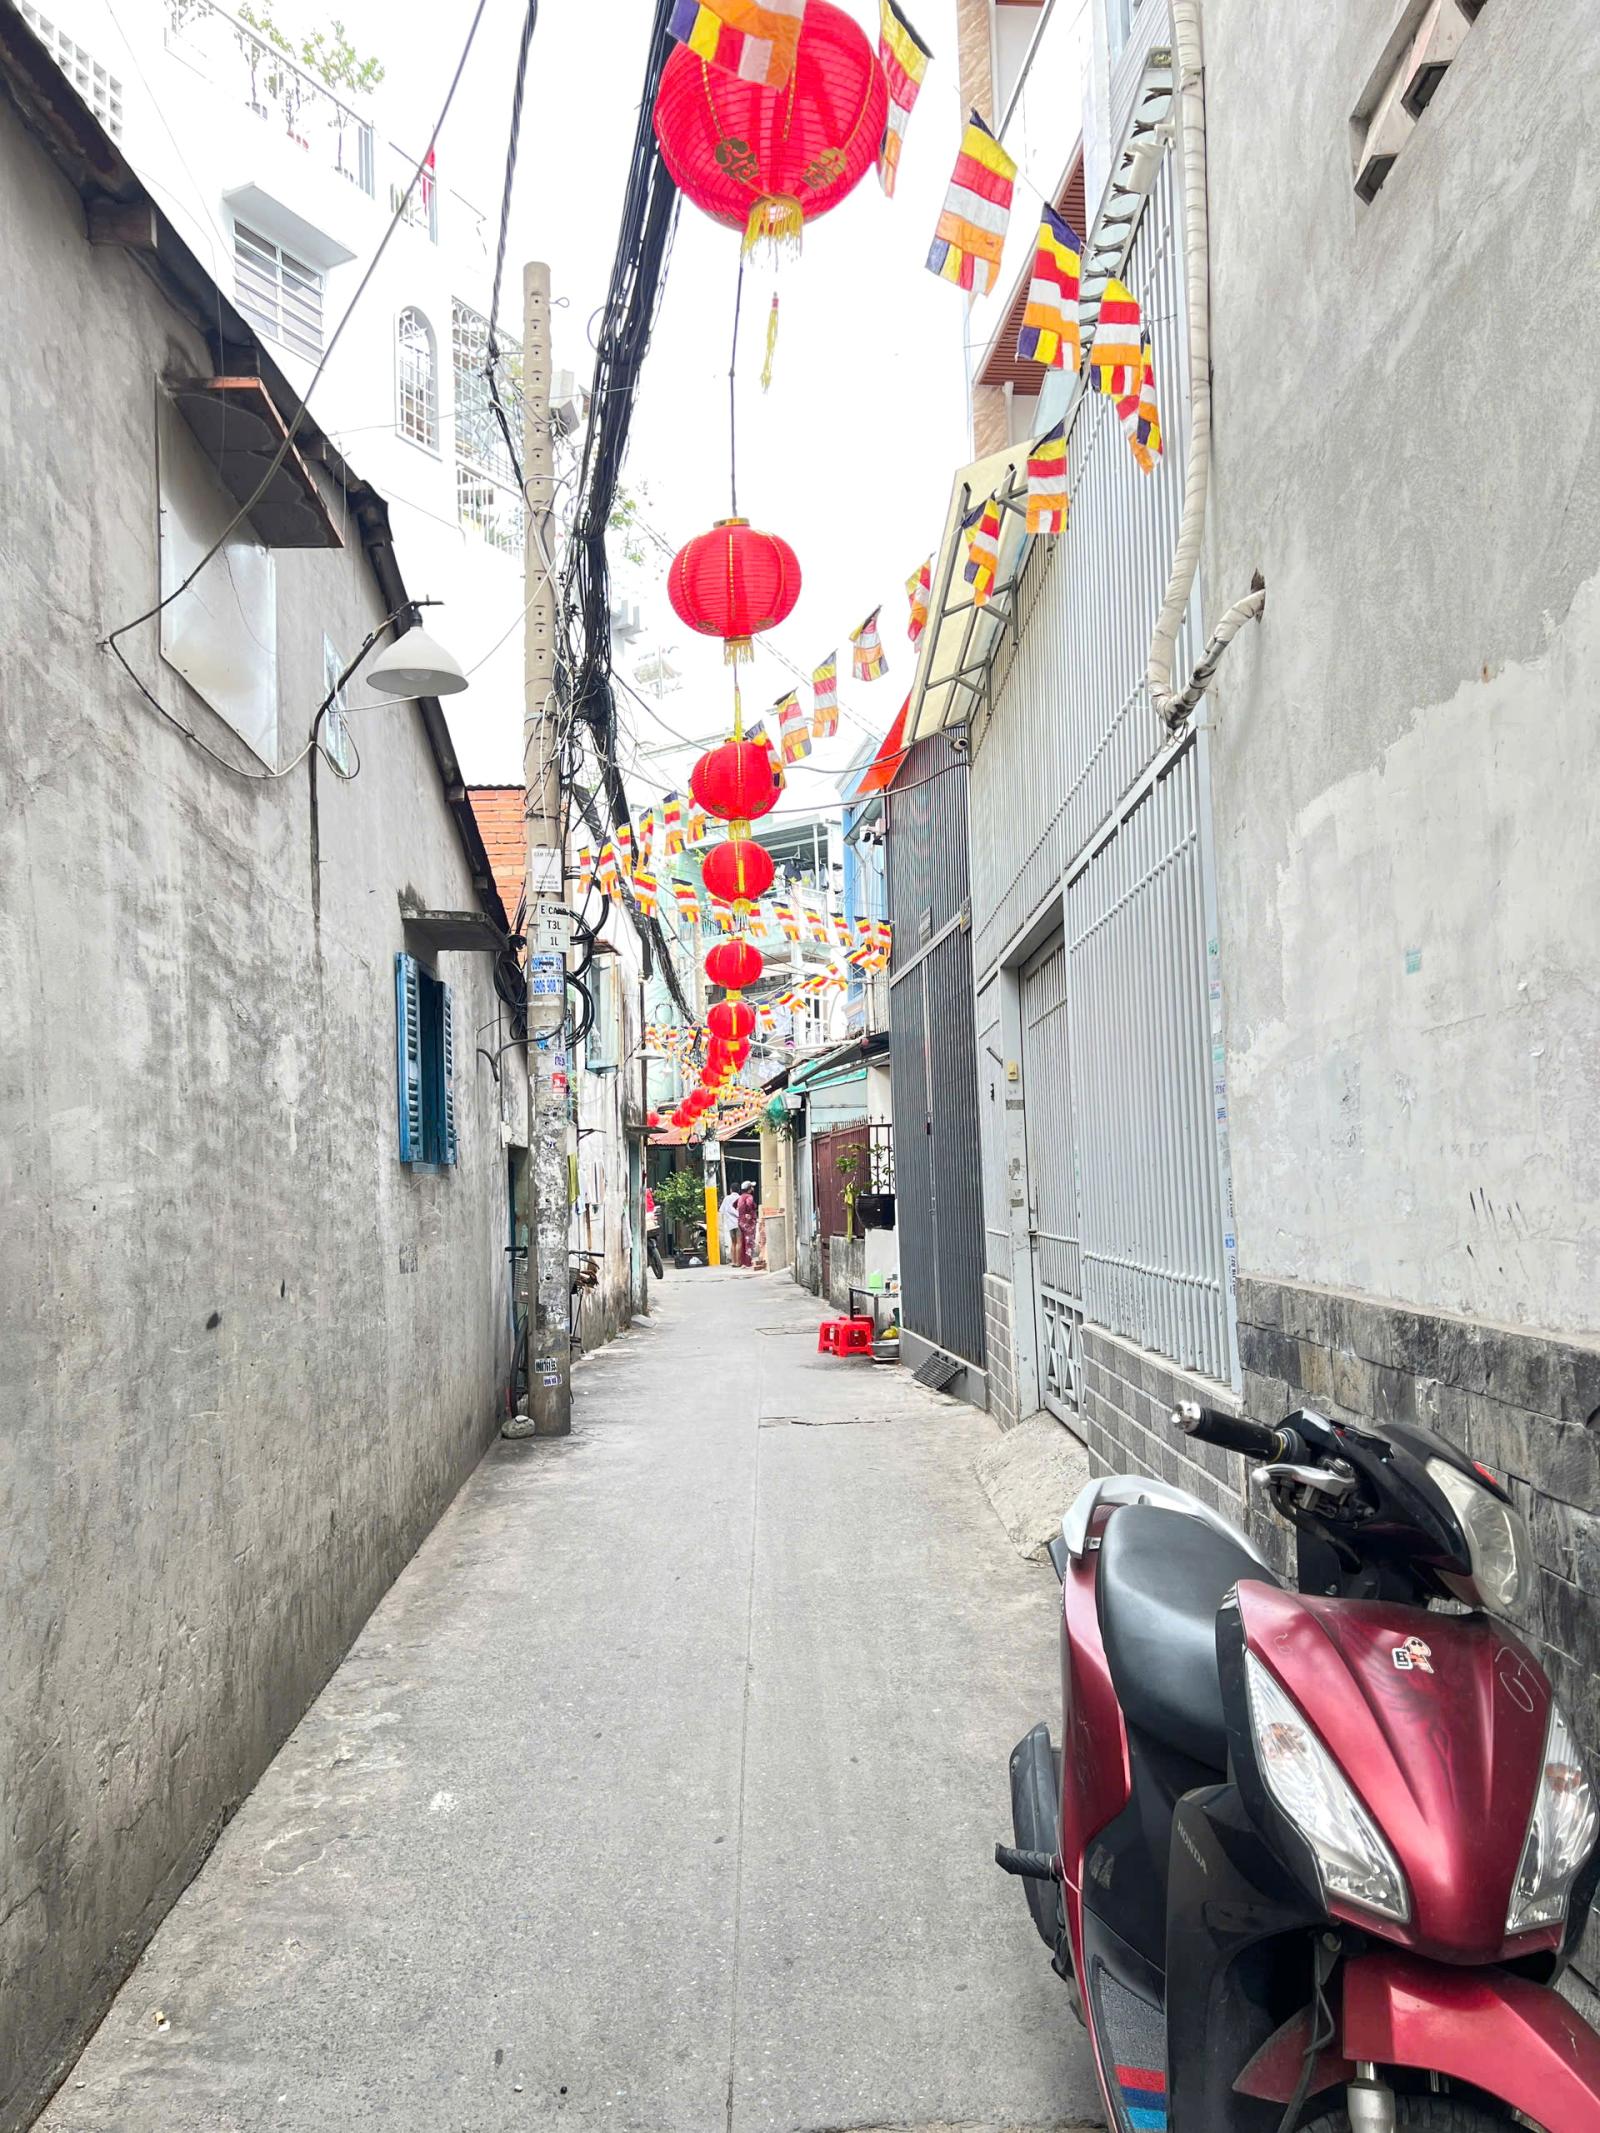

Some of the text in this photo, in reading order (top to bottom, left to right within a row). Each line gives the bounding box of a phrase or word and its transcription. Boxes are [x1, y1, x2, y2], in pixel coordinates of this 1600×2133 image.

[540, 905, 546, 914] E
[547, 920, 562, 930] T3L
[550, 936, 559, 946] 1L
[1177, 1818, 1208, 1875] HONDA
